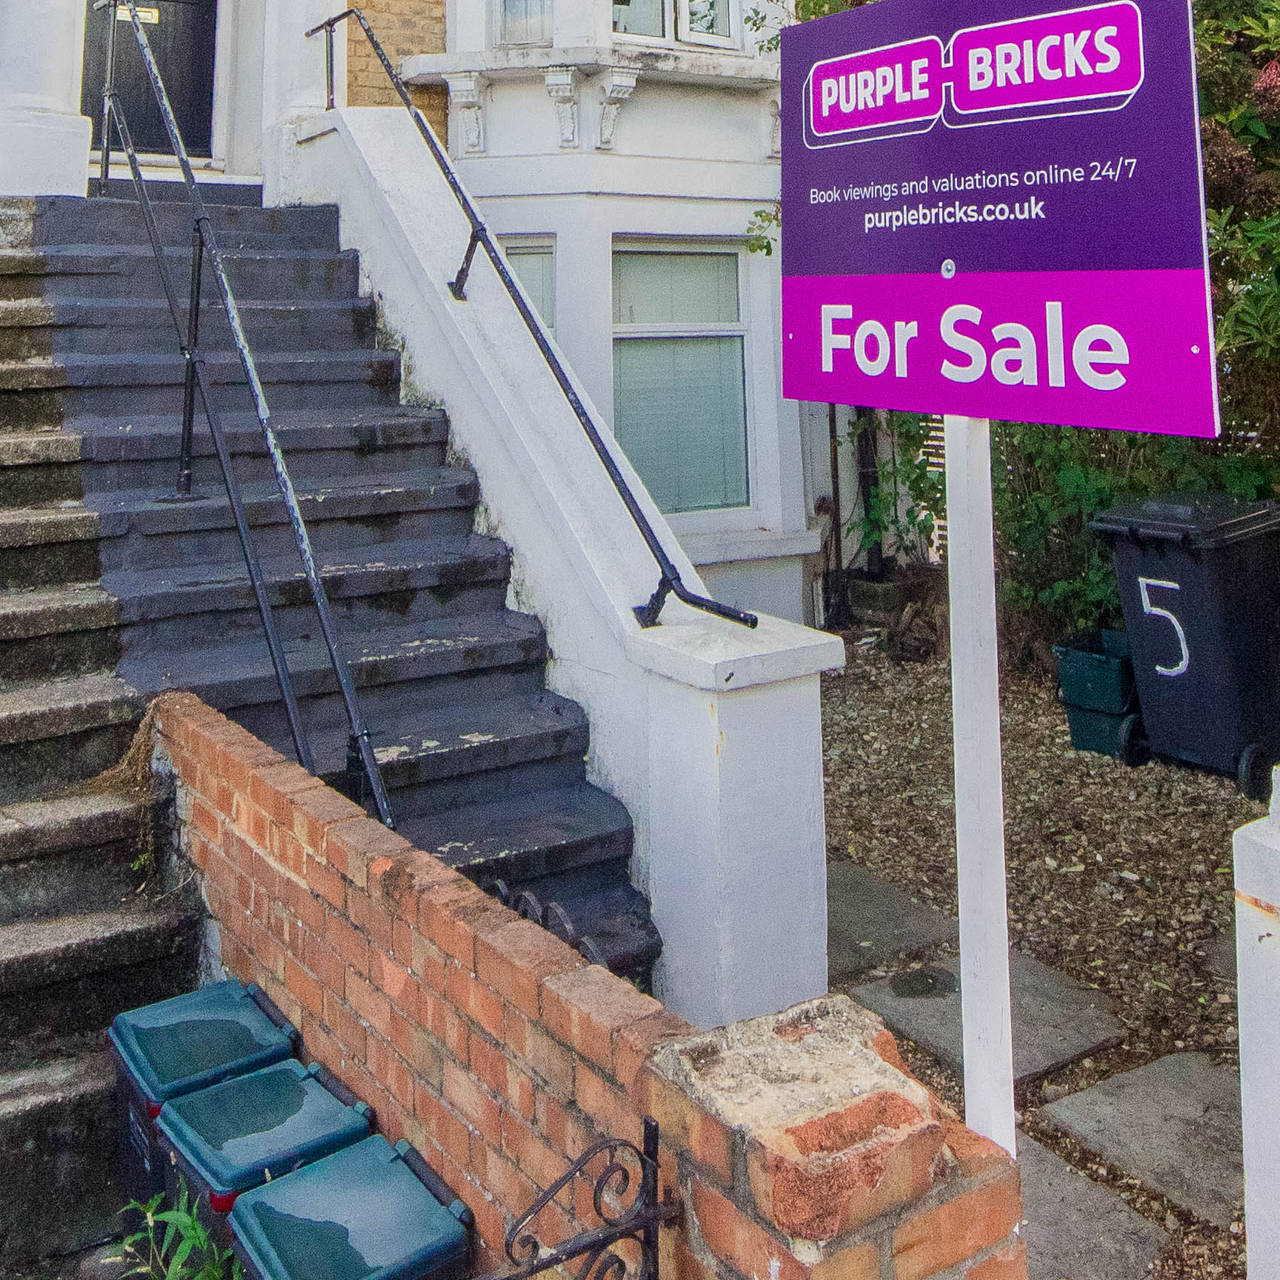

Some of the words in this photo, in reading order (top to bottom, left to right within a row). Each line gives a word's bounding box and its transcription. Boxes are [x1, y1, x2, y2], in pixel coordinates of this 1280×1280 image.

[821, 58, 929, 117] PURPLE
[968, 25, 1121, 92] BRICKS
[809, 188, 841, 205] Book
[842, 183, 898, 202] viewings
[901, 176, 928, 196] and
[932, 170, 1019, 192] valuations
[1023, 164, 1085, 187] online
[1089, 156, 1138, 183] 24/7
[864, 196, 1046, 234] purplebricks.co.uk
[820, 304, 918, 379] For
[939, 301, 1131, 391] Sale
[1138, 576, 1189, 677] 5
